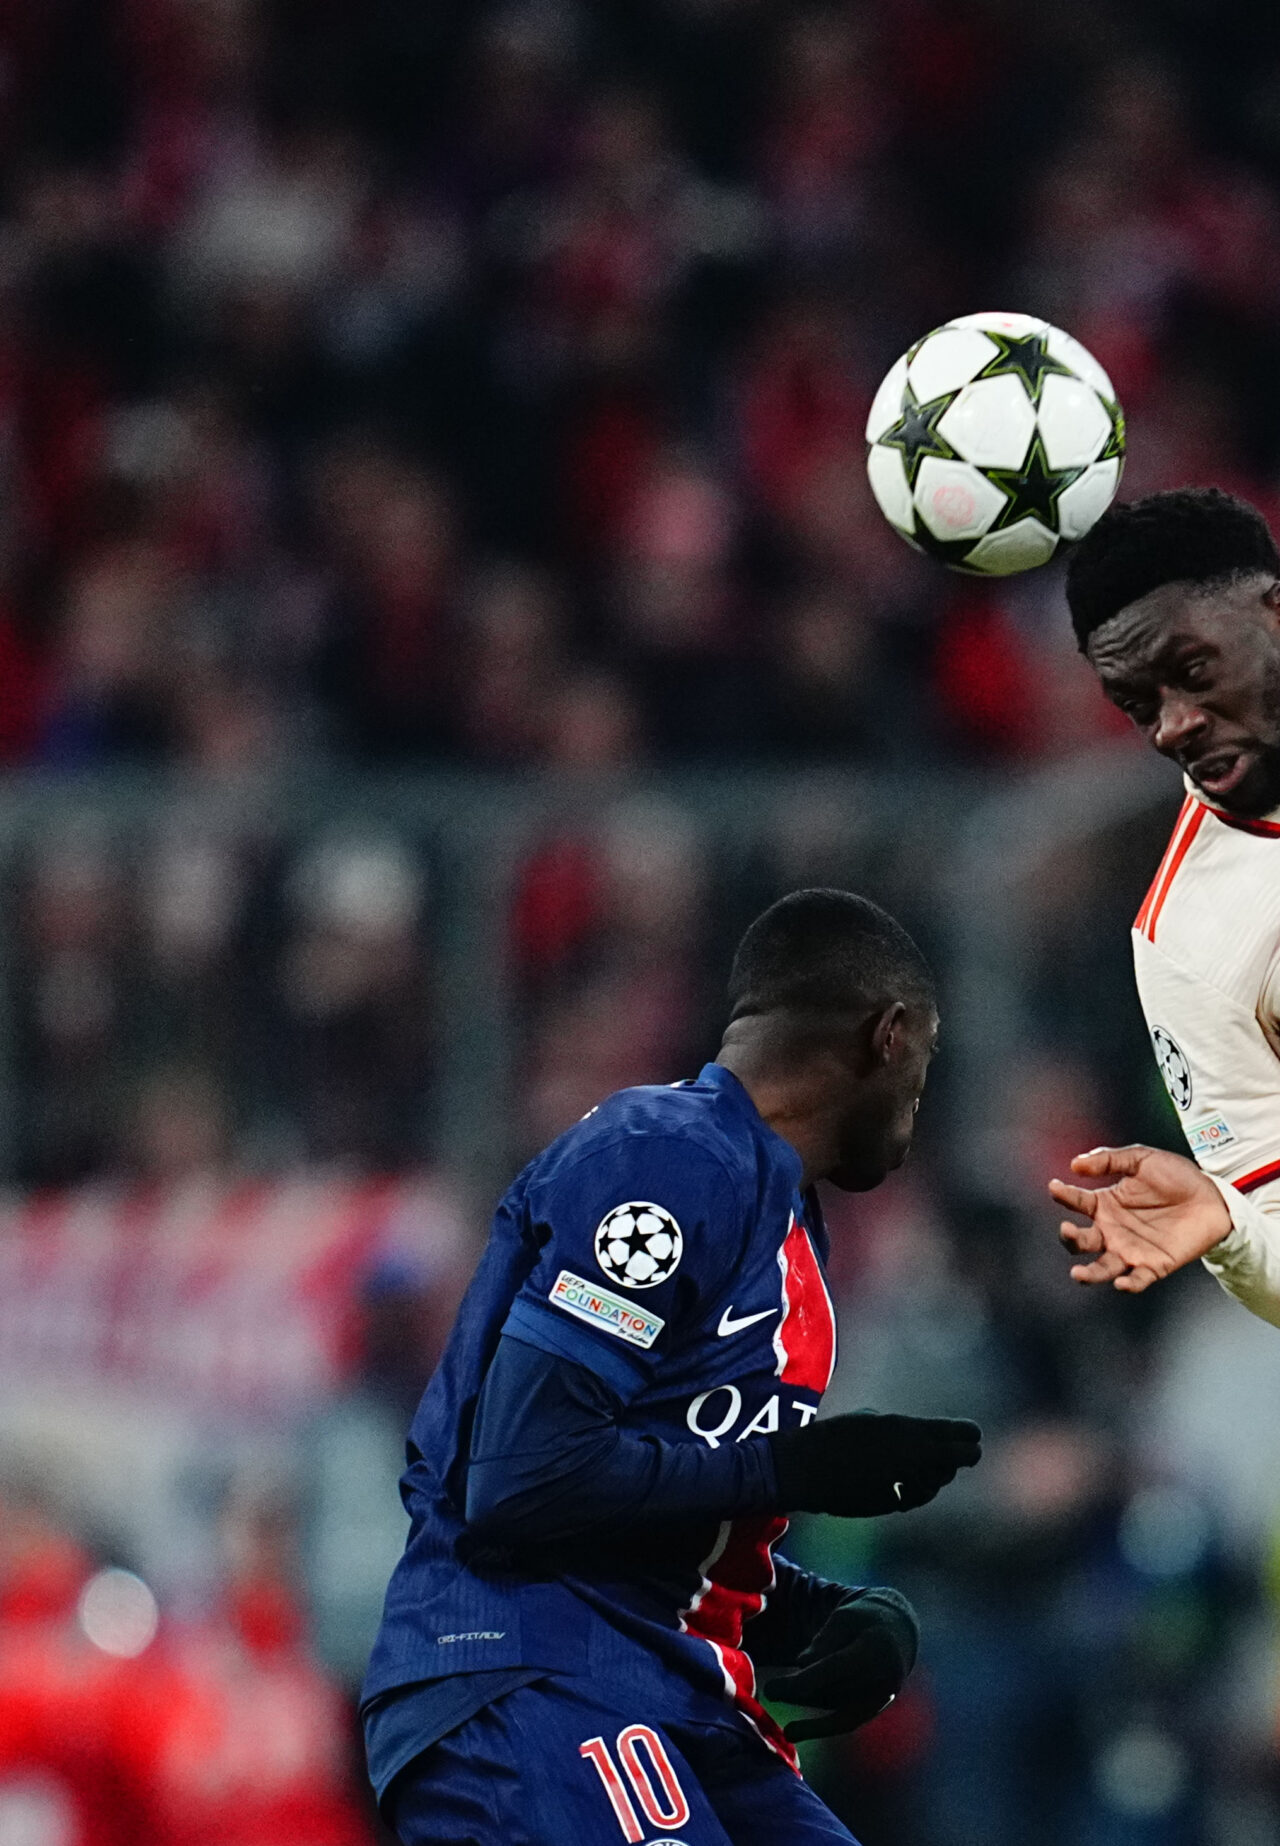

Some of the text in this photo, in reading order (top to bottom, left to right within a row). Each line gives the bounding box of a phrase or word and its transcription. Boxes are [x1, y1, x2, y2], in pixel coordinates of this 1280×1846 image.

[555, 1282, 657, 1337] FOUNDATION
[560, 1274, 586, 1291] UEFA
[578, 1723, 690, 1844] 10
